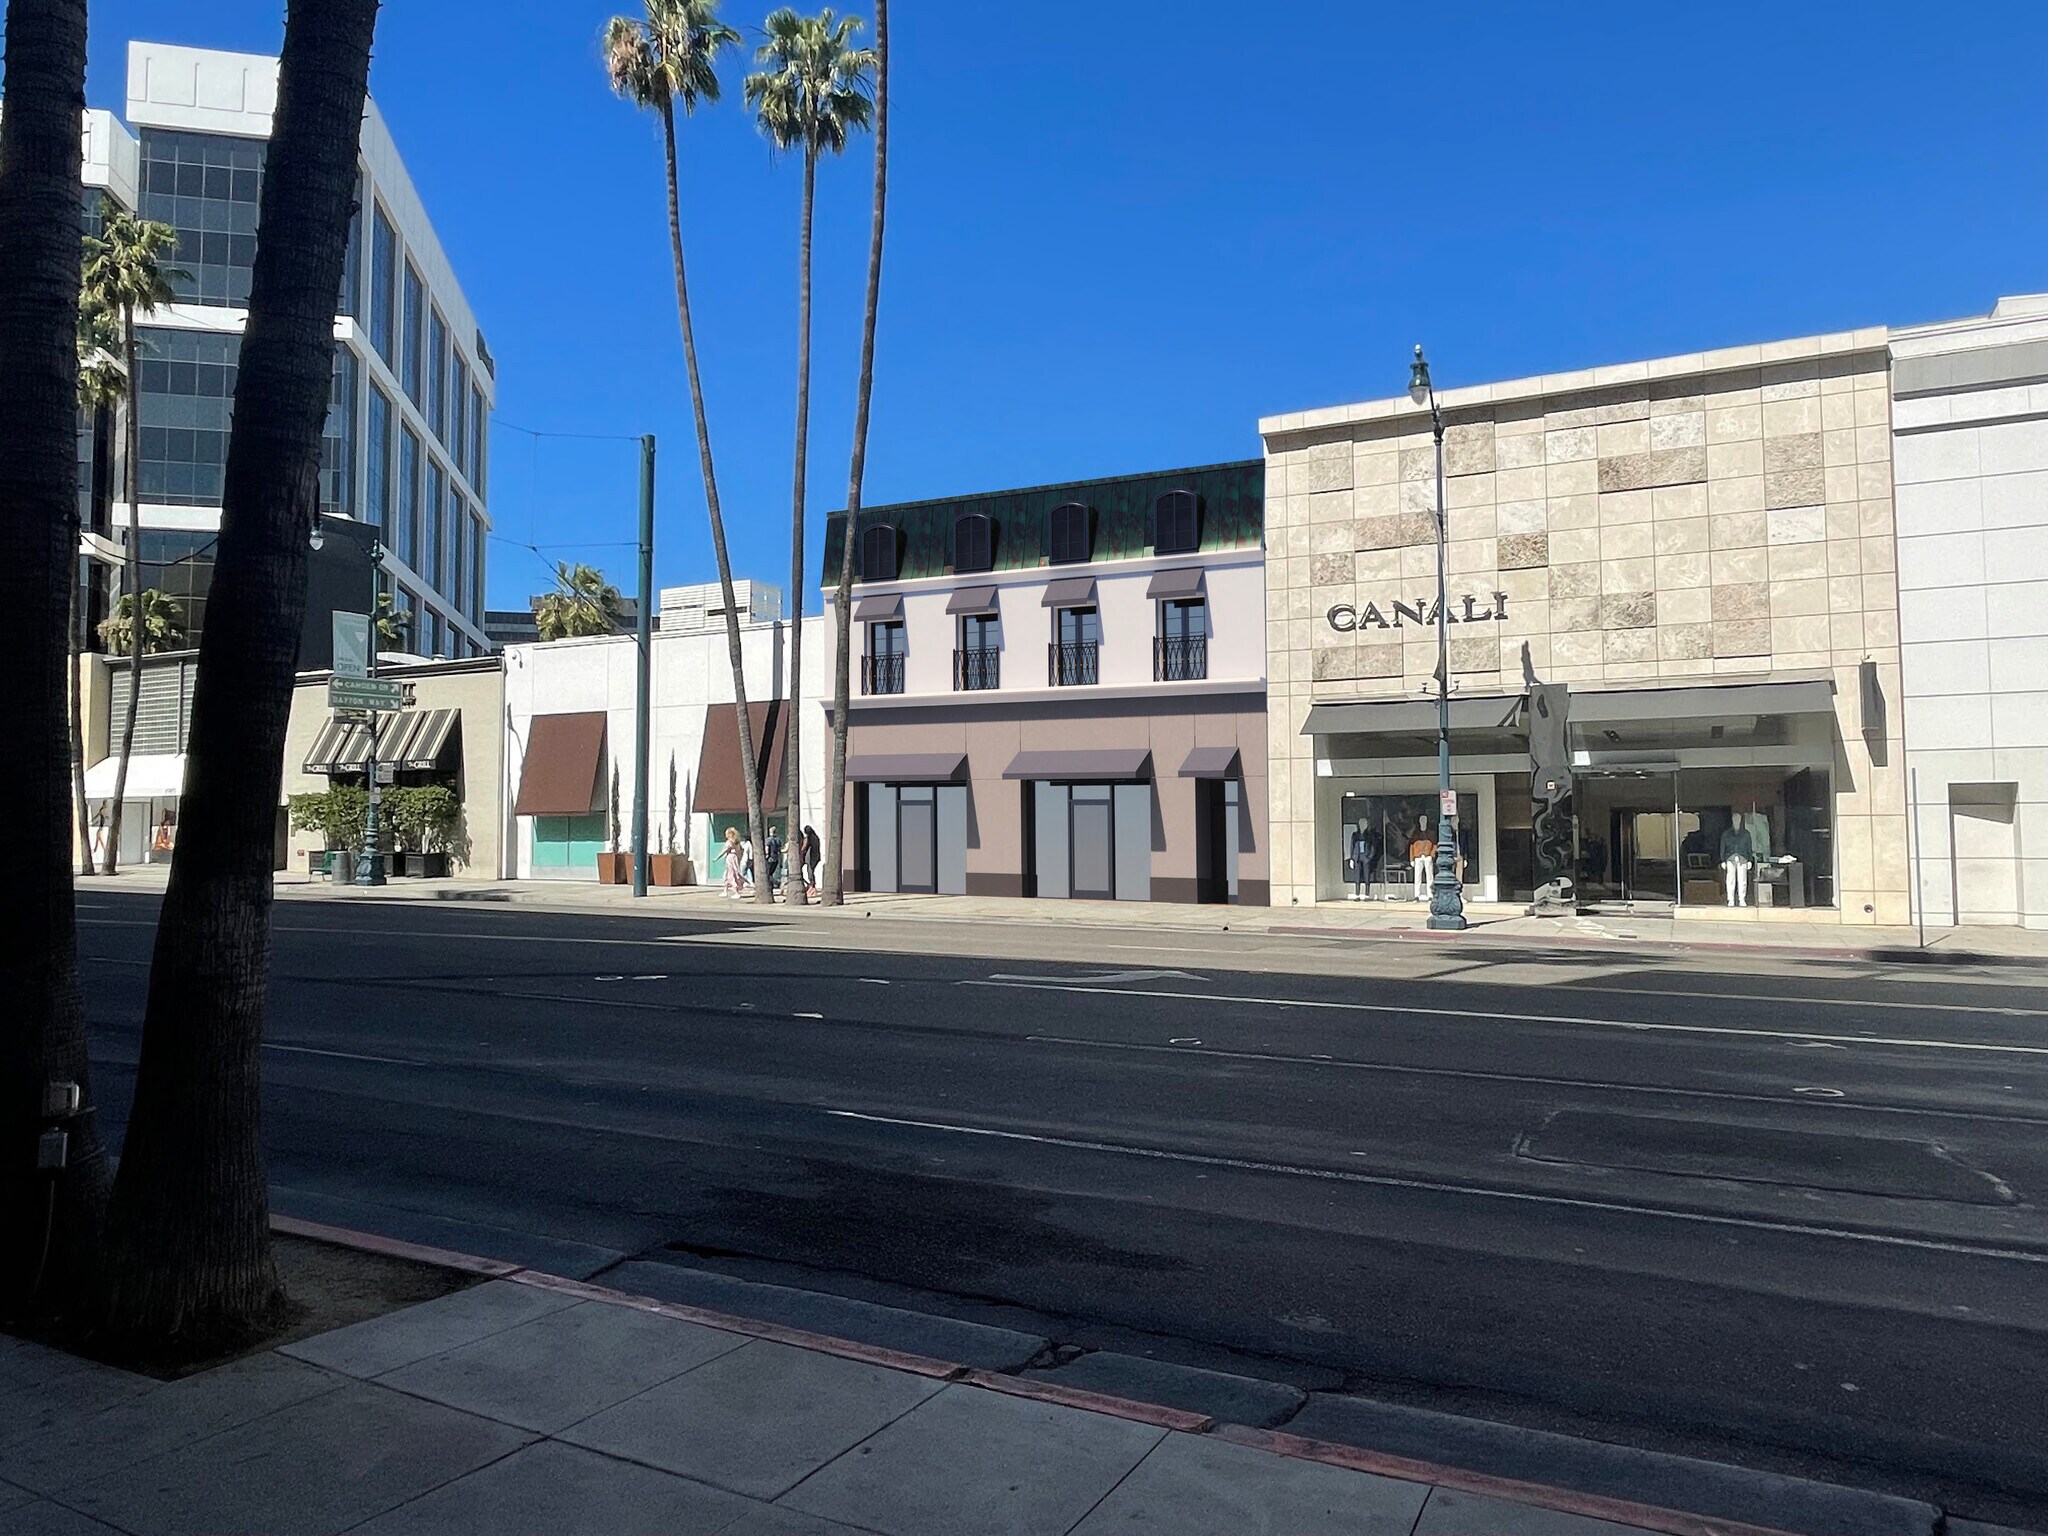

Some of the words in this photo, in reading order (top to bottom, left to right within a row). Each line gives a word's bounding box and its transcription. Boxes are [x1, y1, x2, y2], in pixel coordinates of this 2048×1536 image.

[1326, 591, 1509, 632] CANALI
[337, 663, 360, 672] OPEN
[344, 682, 377, 690] CAMDEN
[332, 696, 364, 705] DAYTON
